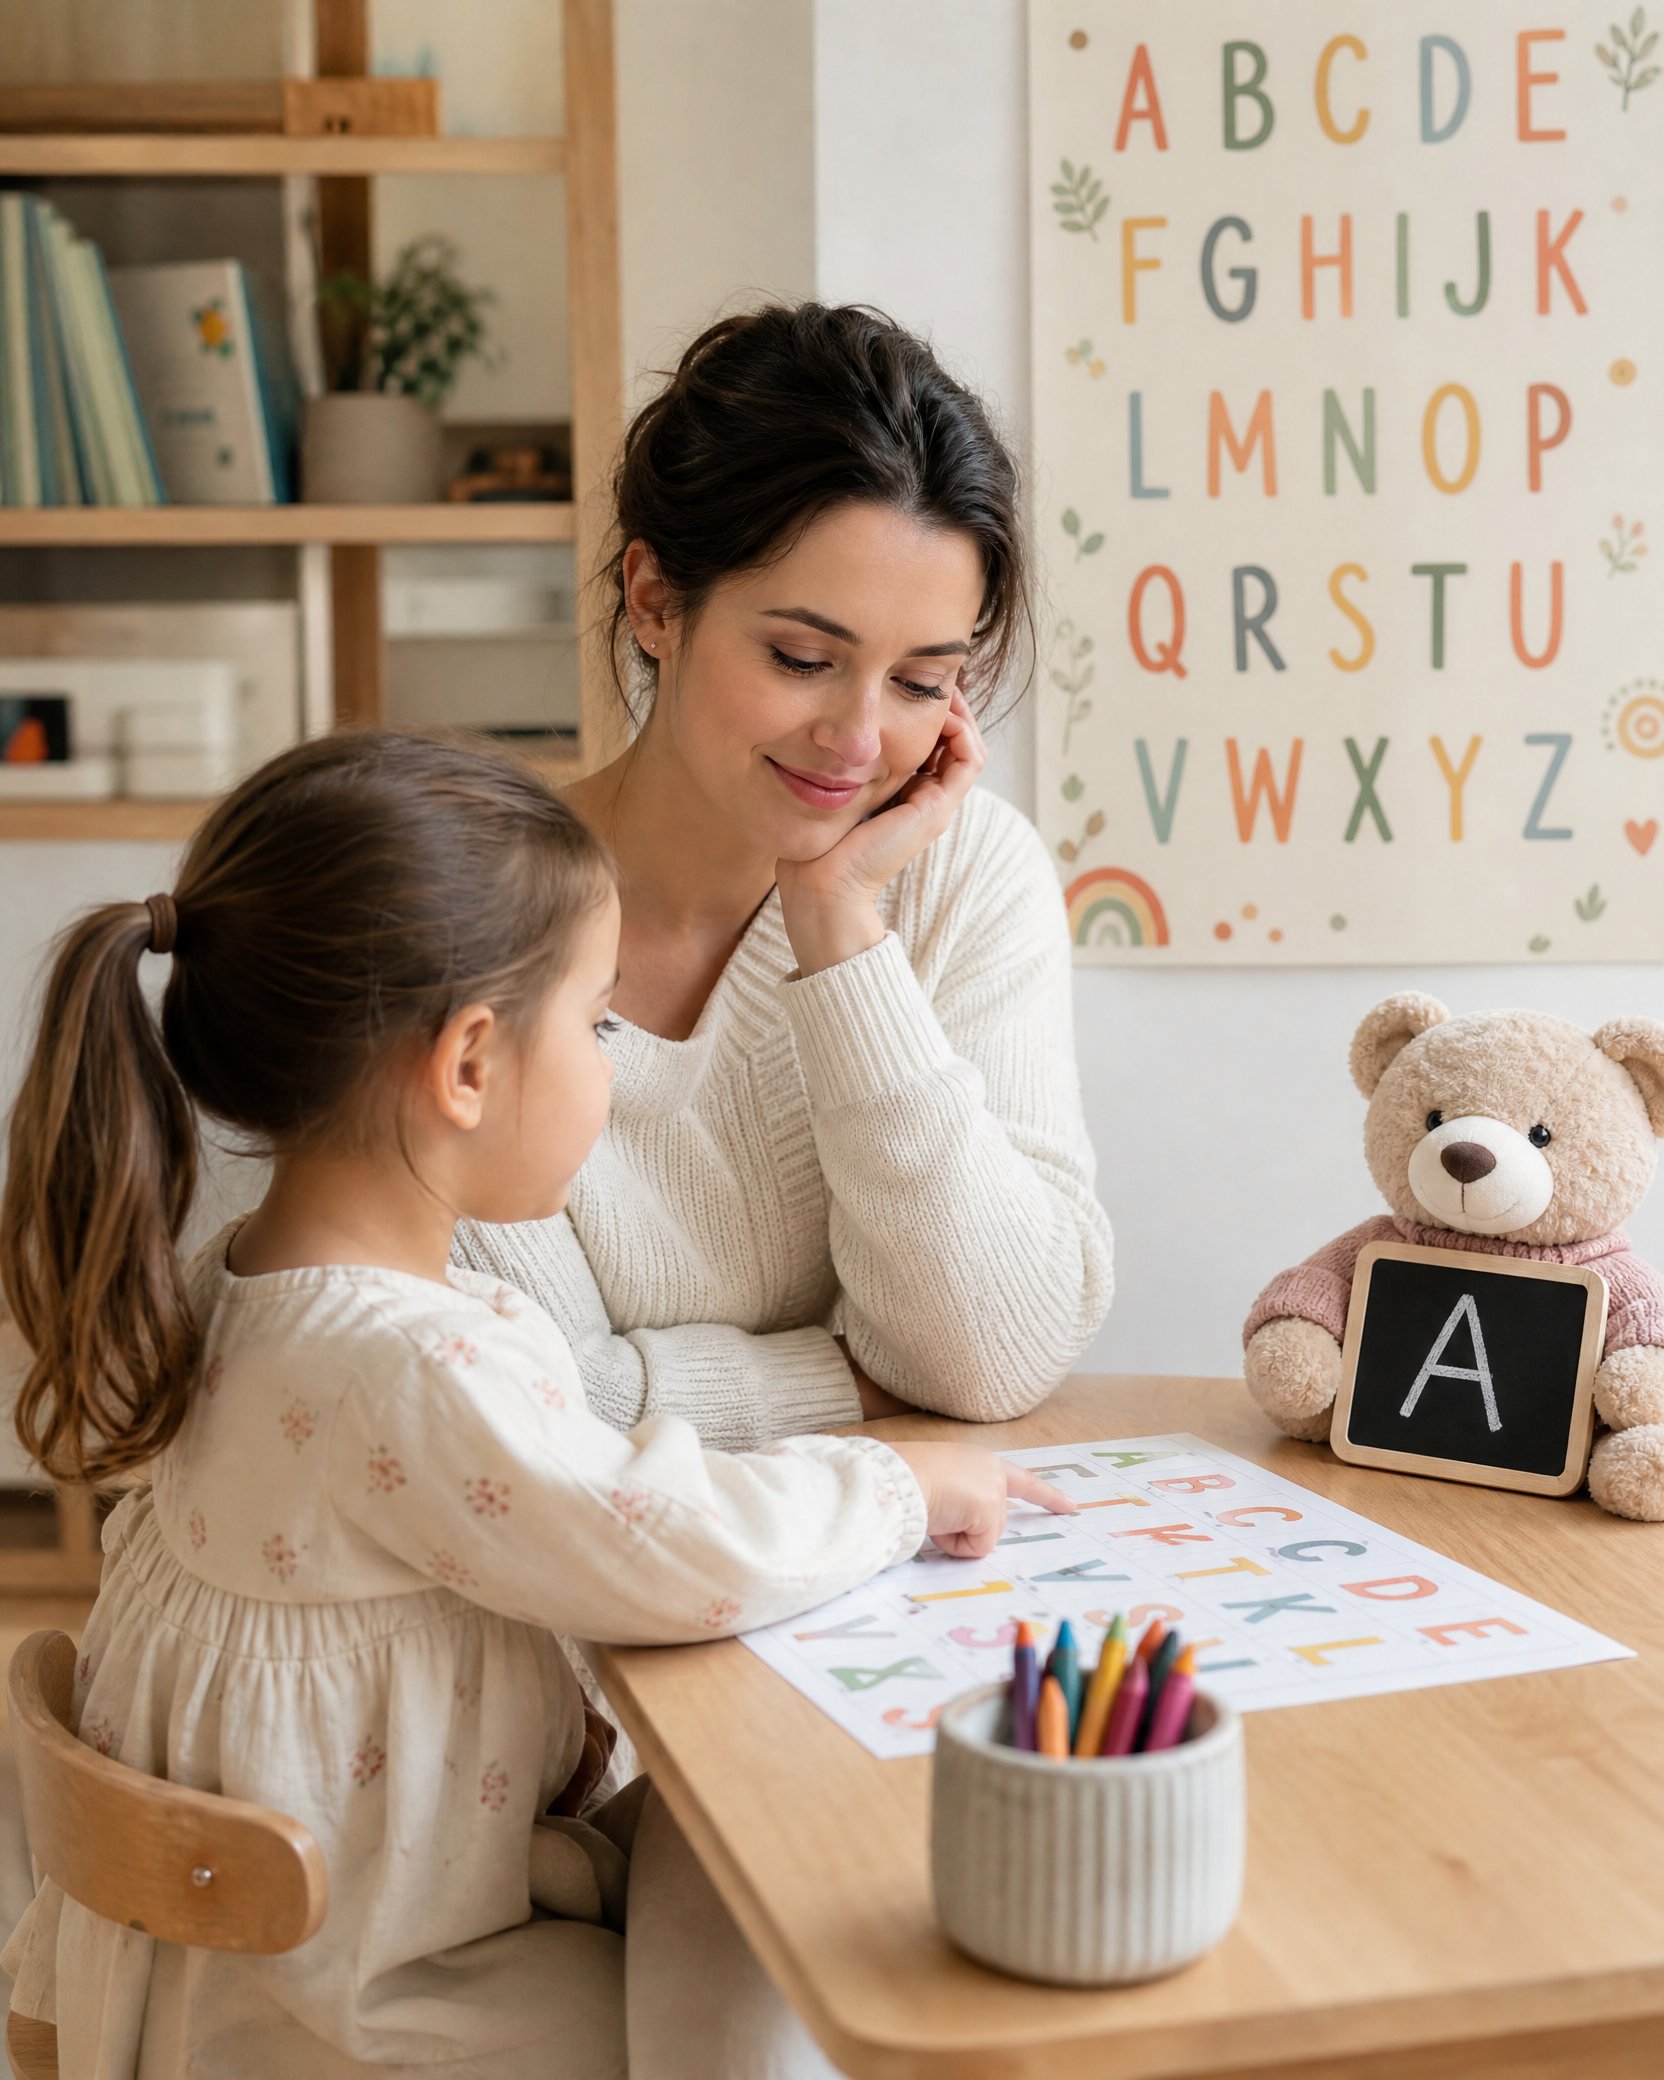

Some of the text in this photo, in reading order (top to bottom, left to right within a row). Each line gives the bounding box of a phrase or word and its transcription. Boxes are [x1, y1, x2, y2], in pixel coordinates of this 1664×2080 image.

[1113, 28, 1567, 153] A B C D E
[1120, 208, 1589, 325] F G H I J K
[1128, 382, 1573, 501] L M N O P
[1127, 560, 1564, 680] Q R S T U
[1133, 732, 1574, 846] V W X Y Z
[1399, 1293, 1503, 1433] A
[1149, 1473, 1236, 1493] B
[1216, 1506, 1303, 1527] C
[1278, 1540, 1367, 1562] C
[1338, 1575, 1439, 1601] D
[1416, 1617, 1530, 1646] E
[1175, 1557, 1273, 1580] T
[1221, 1593, 1338, 1624] K
[1286, 1636, 1385, 1666] L
